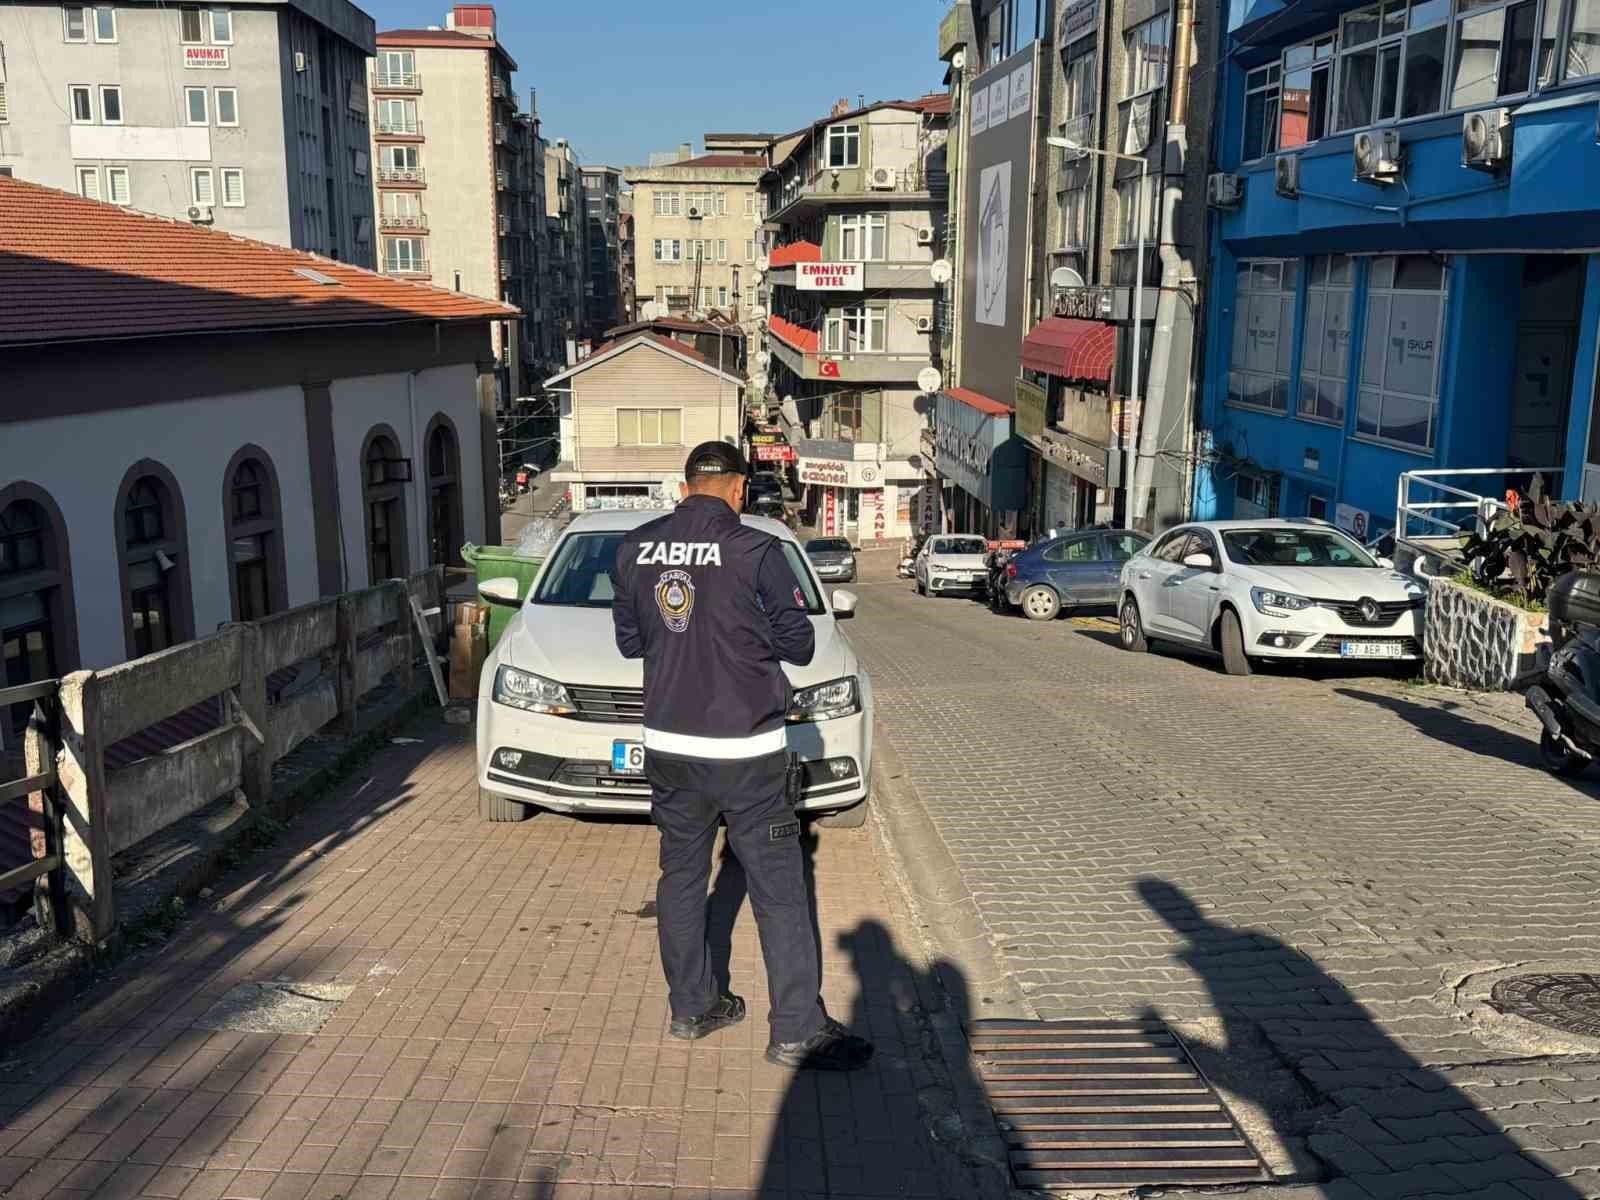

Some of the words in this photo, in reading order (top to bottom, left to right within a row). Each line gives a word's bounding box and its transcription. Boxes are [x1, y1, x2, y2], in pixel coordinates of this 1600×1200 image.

[187, 48, 225, 59] AVUKAT
[802, 264, 856, 275] EMNİYET
[815, 276, 845, 286] OTEL
[801, 471, 849, 484] eczanesi
[874, 488, 885, 540] CZANE
[636, 541, 722, 567] ZABITA
[630, 746, 642, 766] 6
